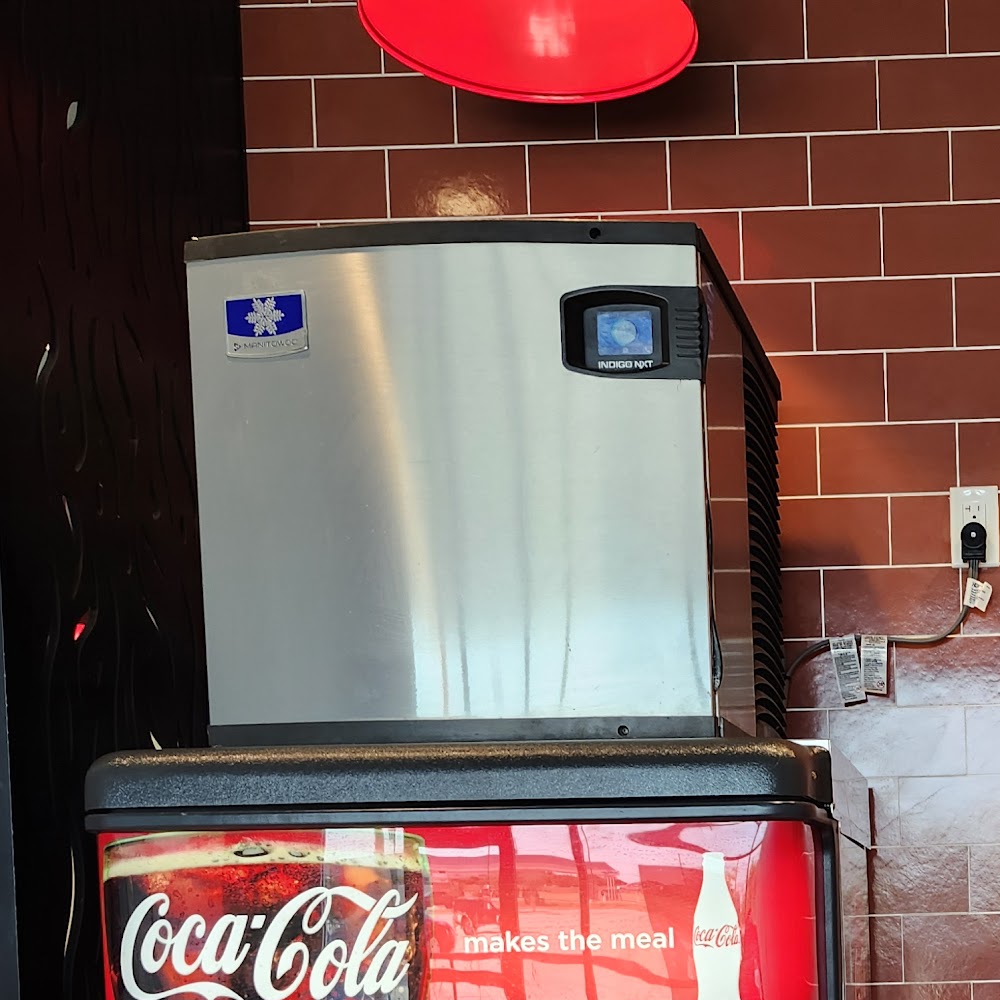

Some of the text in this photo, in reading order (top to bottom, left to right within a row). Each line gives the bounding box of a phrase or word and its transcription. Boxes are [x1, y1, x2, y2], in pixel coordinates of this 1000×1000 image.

[598, 360, 654, 369] INDIGO NXT
[463, 927, 675, 953] makes the meal
[694, 924, 741, 949] Coca-Cola
